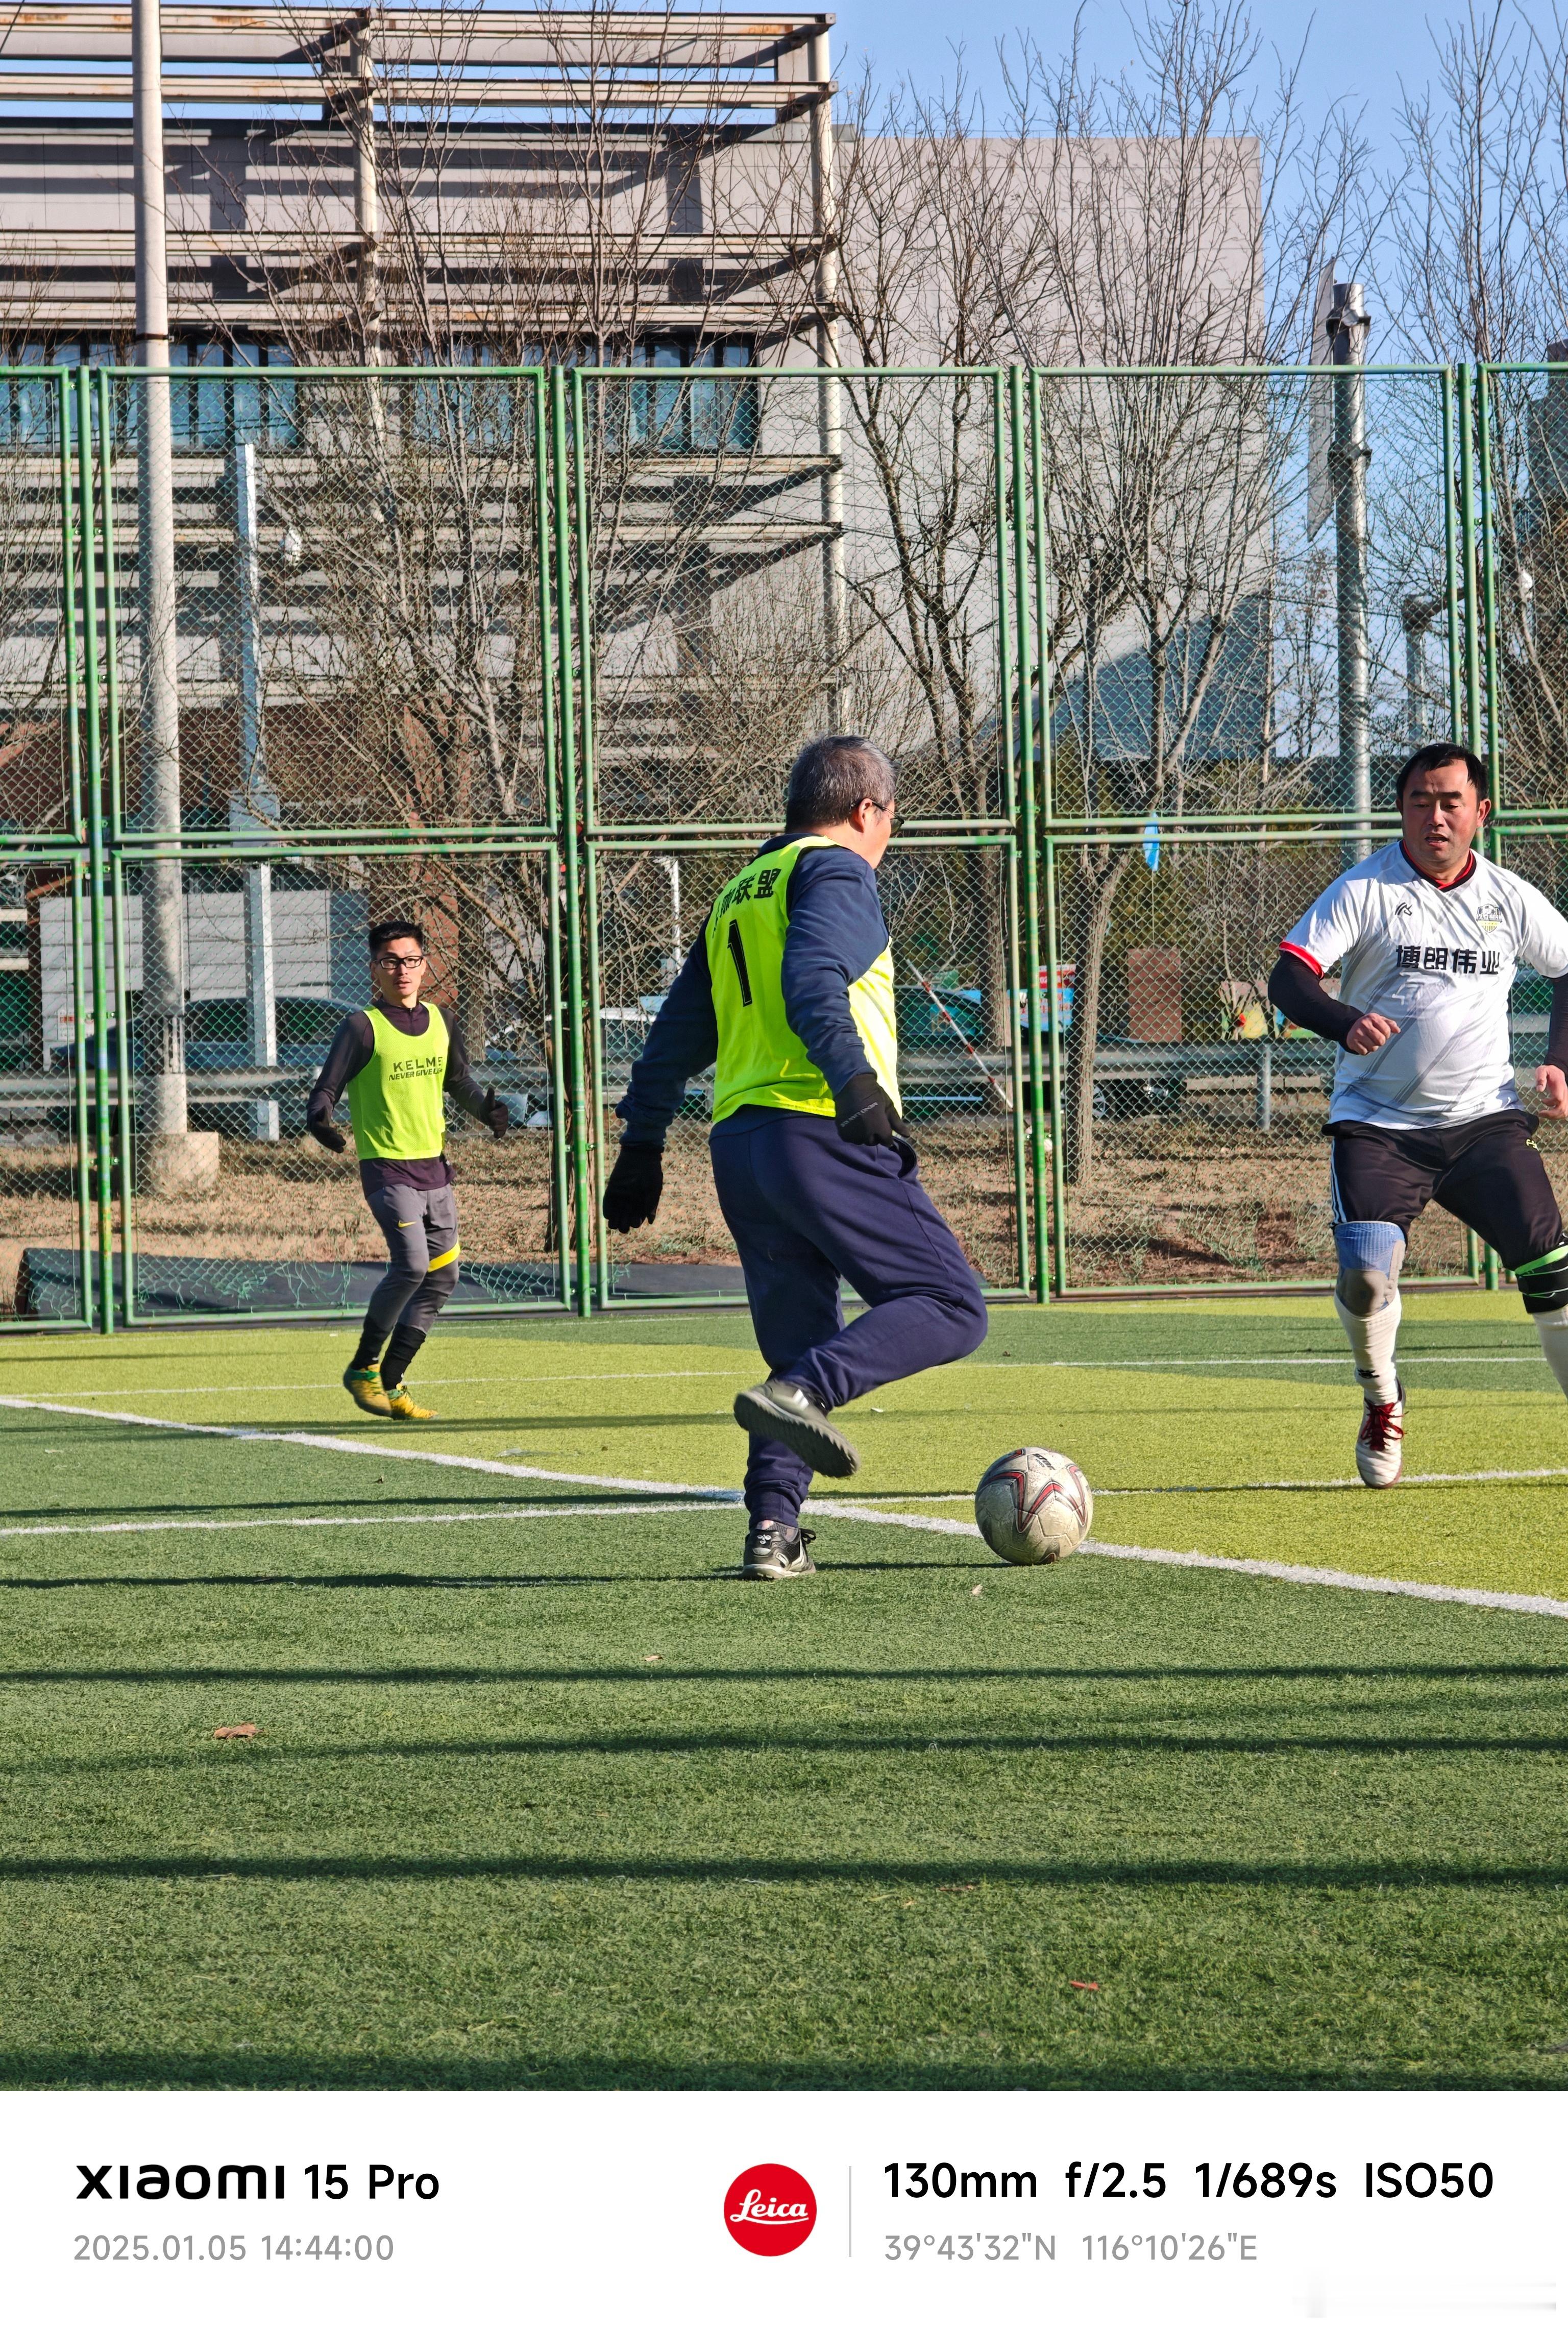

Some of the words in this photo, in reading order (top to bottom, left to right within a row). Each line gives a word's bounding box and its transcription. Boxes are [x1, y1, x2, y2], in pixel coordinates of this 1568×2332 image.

[727, 919, 752, 1007] 1
[1396, 945, 1500, 975] 博朗伟业
[389, 1071, 414, 1081] NEVER
[416, 1068, 432, 1077] GIVE
[393, 1057, 443, 1072] KELME
